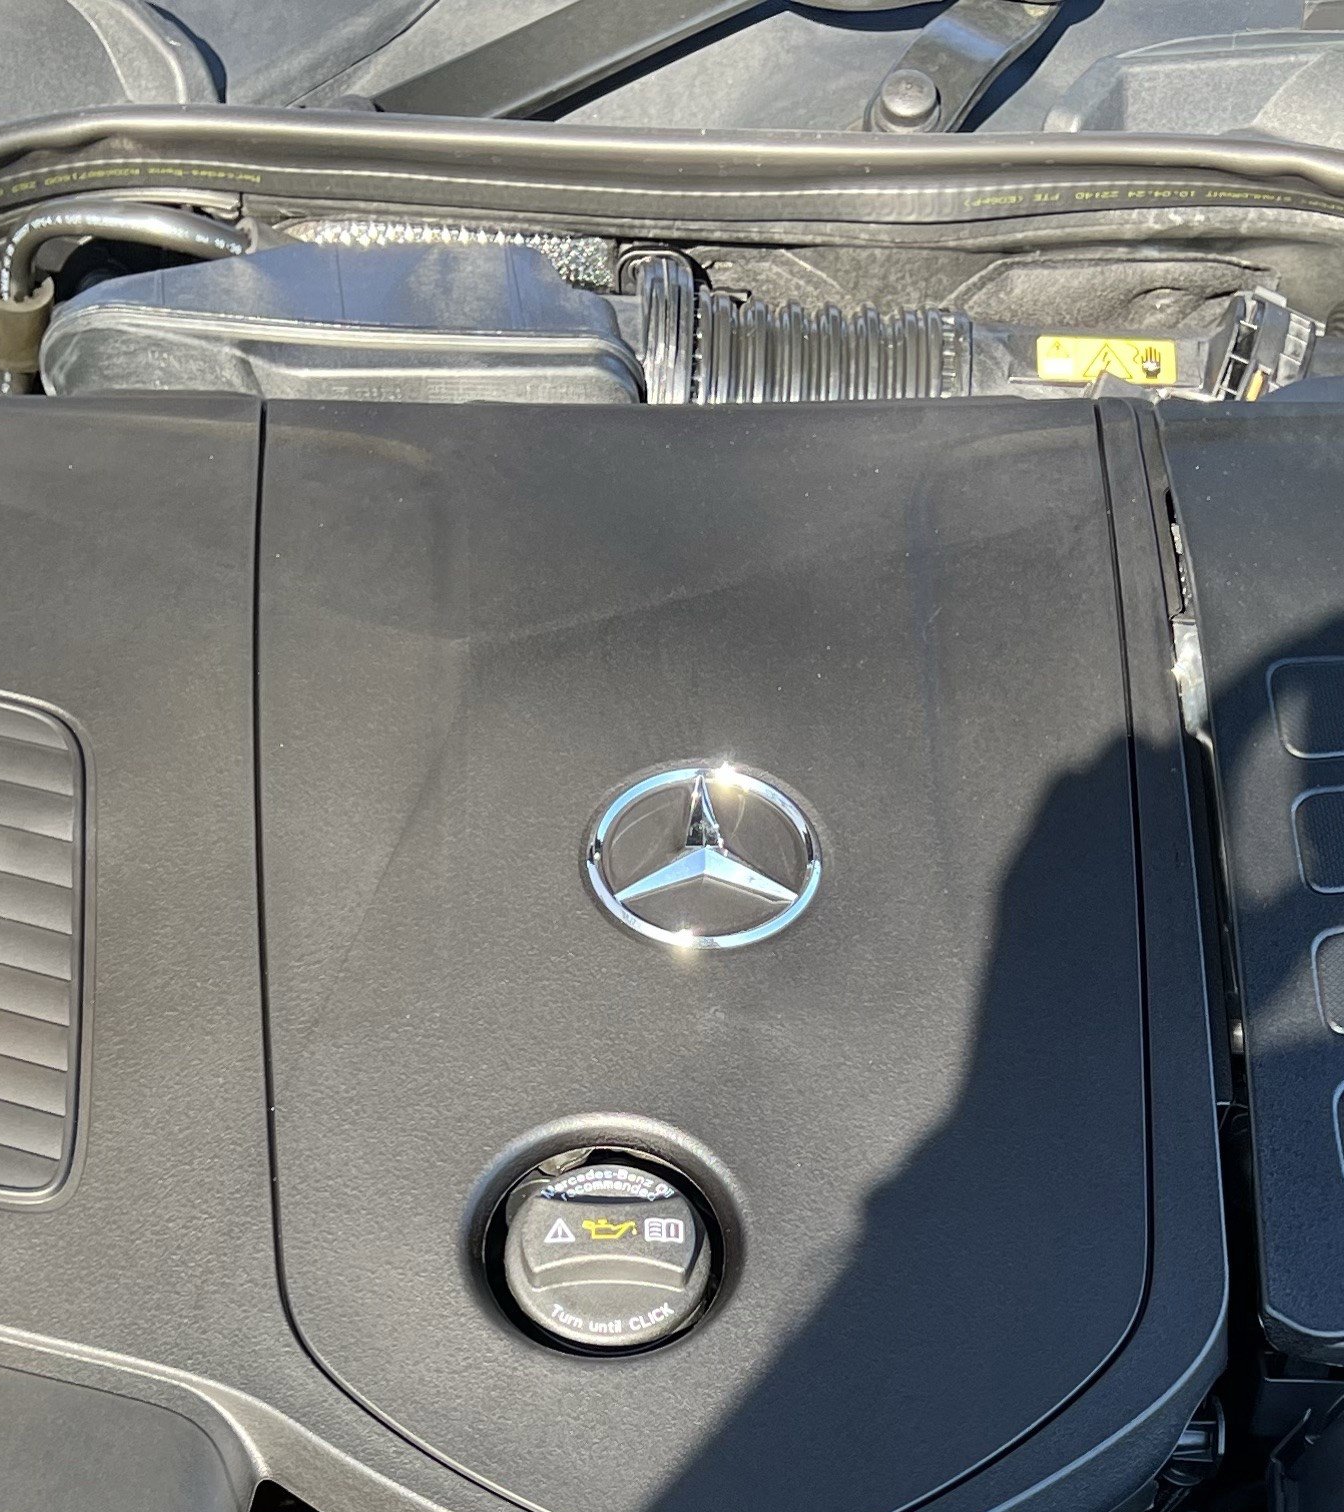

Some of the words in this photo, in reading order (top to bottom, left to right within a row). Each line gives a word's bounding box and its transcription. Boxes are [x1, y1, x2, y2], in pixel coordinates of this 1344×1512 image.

[541, 1168, 654, 1199] Mercedes-Benz
[656, 1183, 675, 1198] Oil
[560, 1180, 657, 1202] recommended
[551, 1303, 583, 1328] Turn
[588, 1319, 622, 1333] until
[629, 1302, 675, 1331] CLICK
